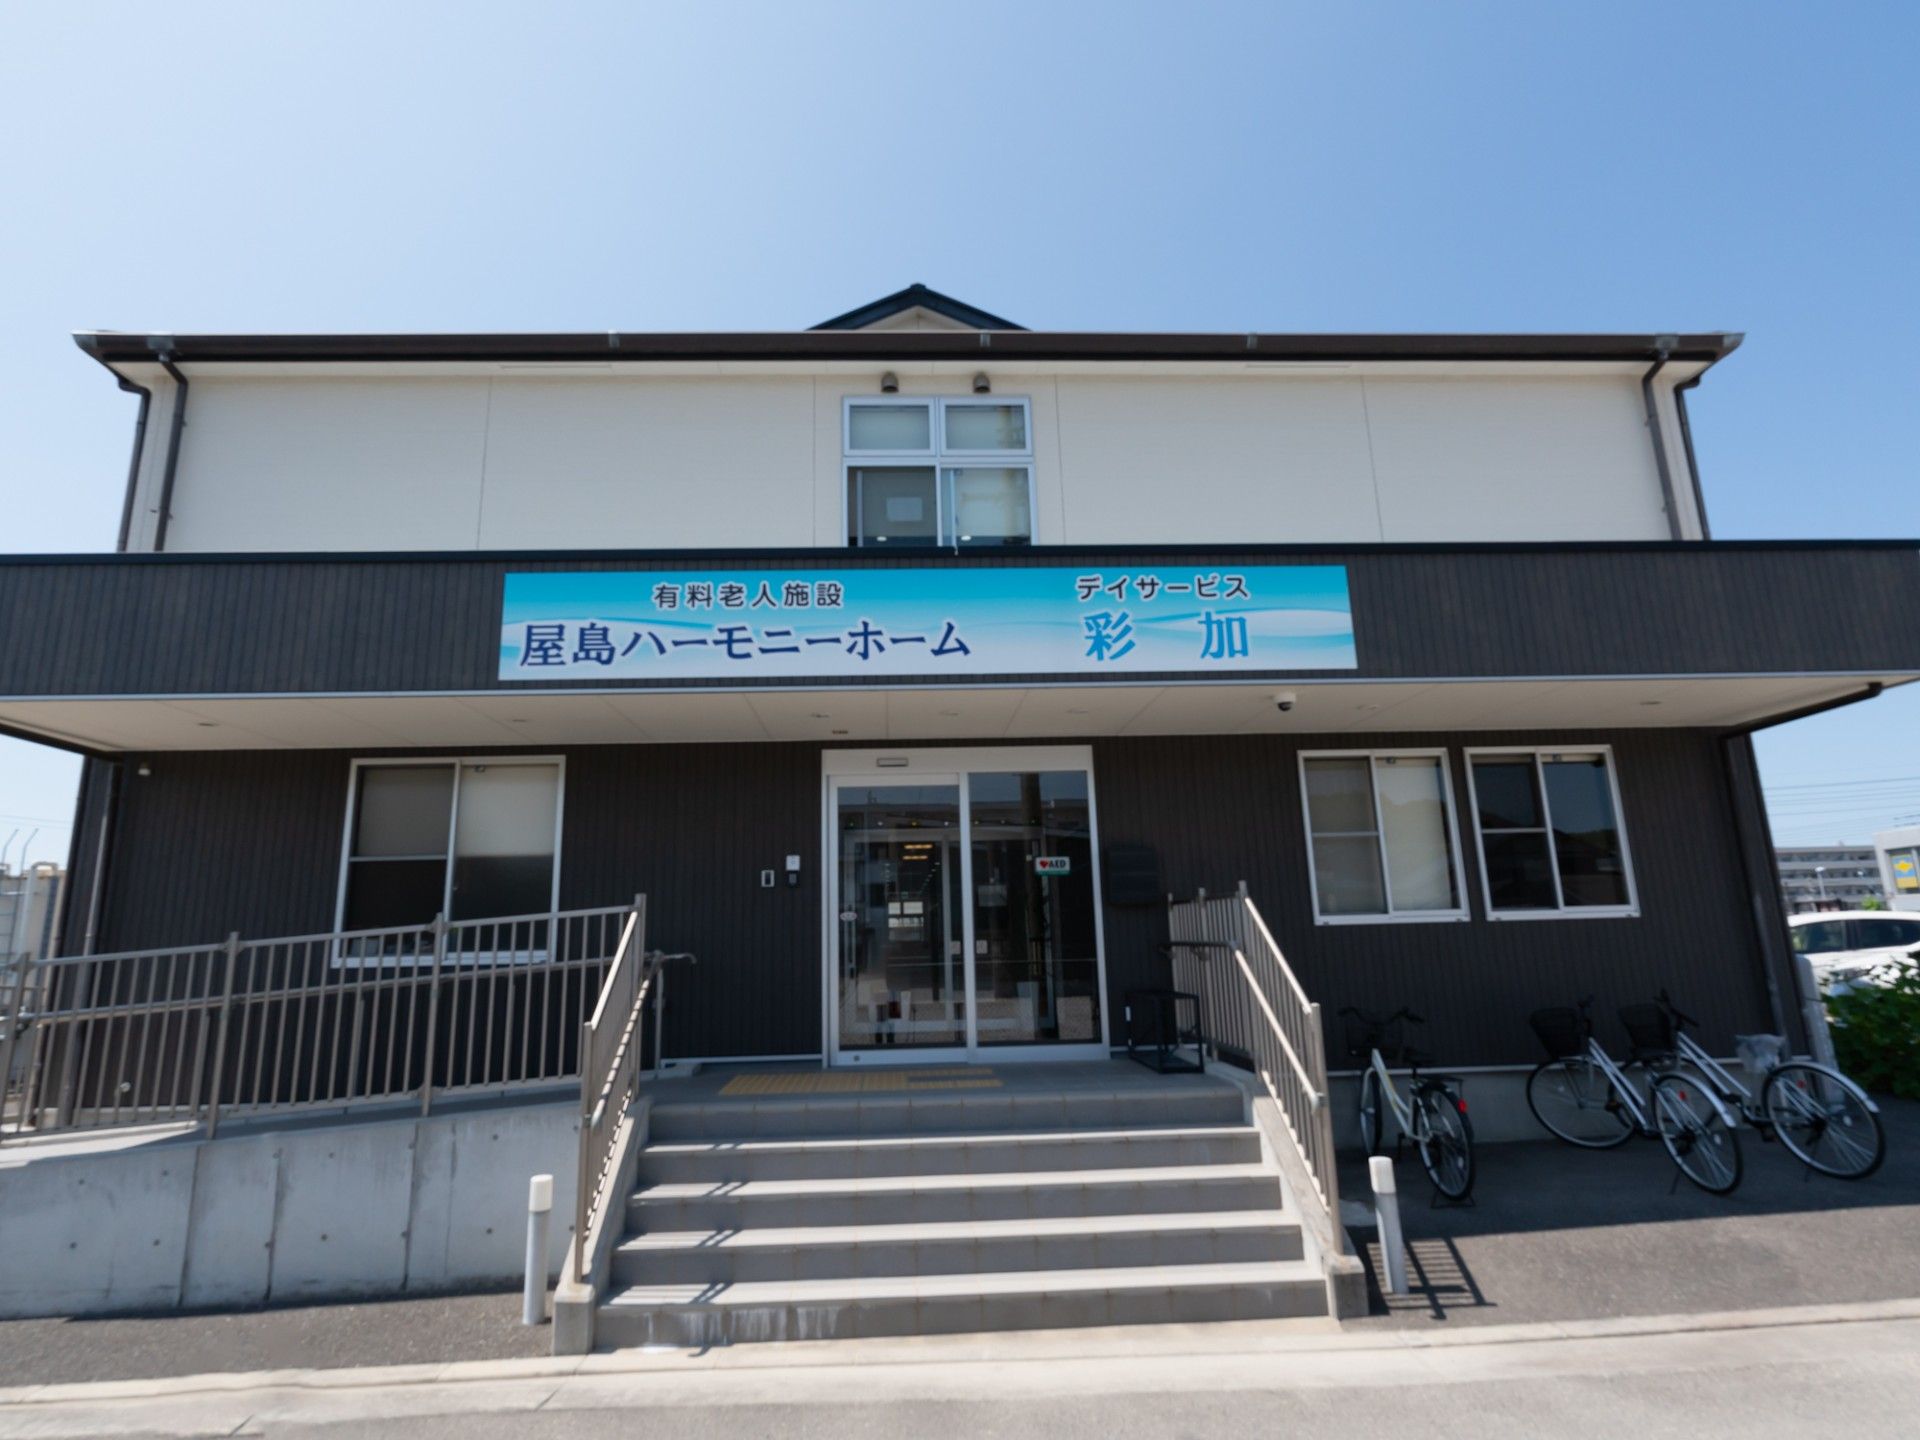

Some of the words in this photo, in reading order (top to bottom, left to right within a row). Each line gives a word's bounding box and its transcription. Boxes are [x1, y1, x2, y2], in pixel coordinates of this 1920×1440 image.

[652, 582, 845, 608] 有料老人施設
[1077, 575, 1250, 600] デイサービス
[519, 621, 972, 667] 屋島ハーモニーホーム
[1049, 859, 1066, 868] AED
